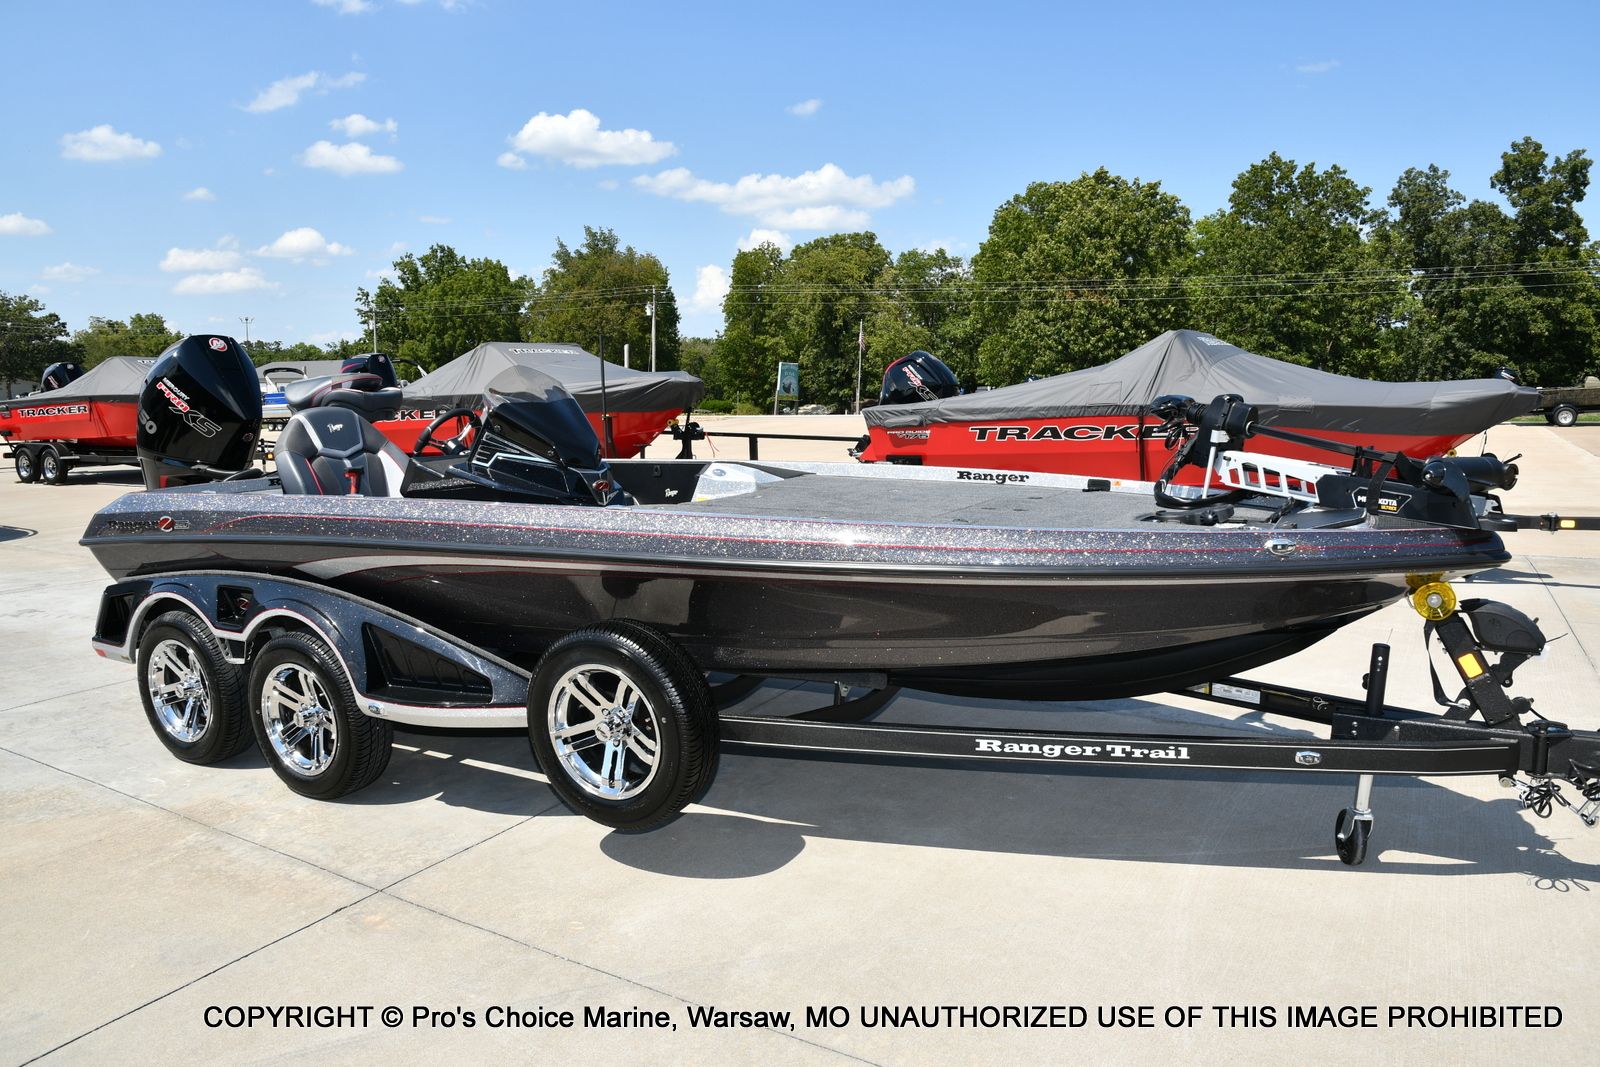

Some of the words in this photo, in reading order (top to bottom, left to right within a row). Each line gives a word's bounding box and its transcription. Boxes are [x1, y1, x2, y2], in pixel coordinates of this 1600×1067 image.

[156, 381, 190, 412] PRO
[162, 377, 190, 401] MERCURY
[18, 405, 89, 418] TRACKER
[138, 407, 157, 435] 50
[168, 406, 222, 438] XS
[956, 470, 1030, 484] Ranger
[1378, 498, 1398, 507] KOTA
[975, 738, 1102, 757] Ranger
[1106, 744, 1191, 760] Trail
